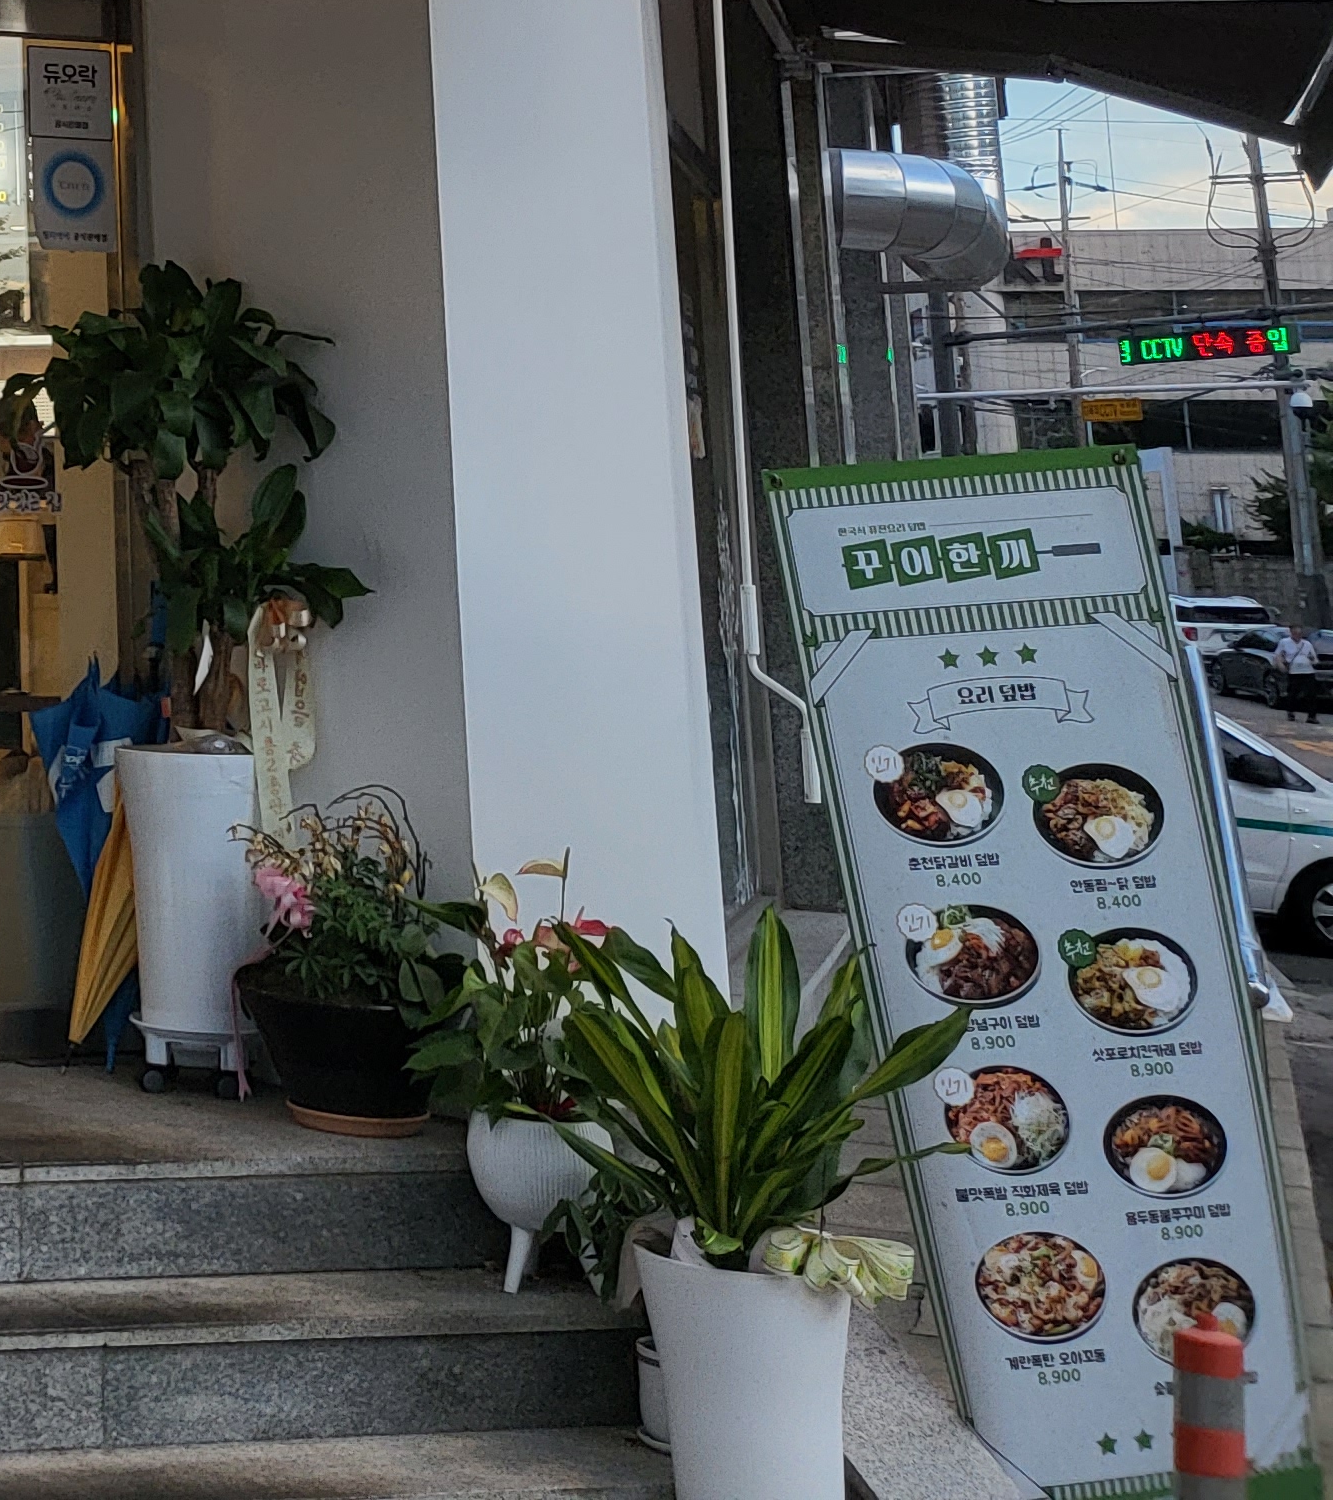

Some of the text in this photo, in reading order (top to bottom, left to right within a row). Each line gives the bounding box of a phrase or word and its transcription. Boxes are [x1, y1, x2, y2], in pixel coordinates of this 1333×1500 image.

[43, 63, 97, 88] 듀오락
[1140, 337, 1183, 360] CCTV
[1191, 331, 1234, 357] 단속
[957, 682, 1037, 705] 요리 덮밥
[907, 852, 1001, 871] 춘천닭갈비 덮밥
[1132, 875, 1157, 890] 덮밥
[1015, 1014, 1041, 1030] 덮밥
[1178, 1040, 1203, 1057] 덮밥
[1064, 1180, 1089, 1196] 덮밥
[1207, 1203, 1232, 1219] 덮밥
[1004, 1354, 1056, 1371] 계란폭탄
